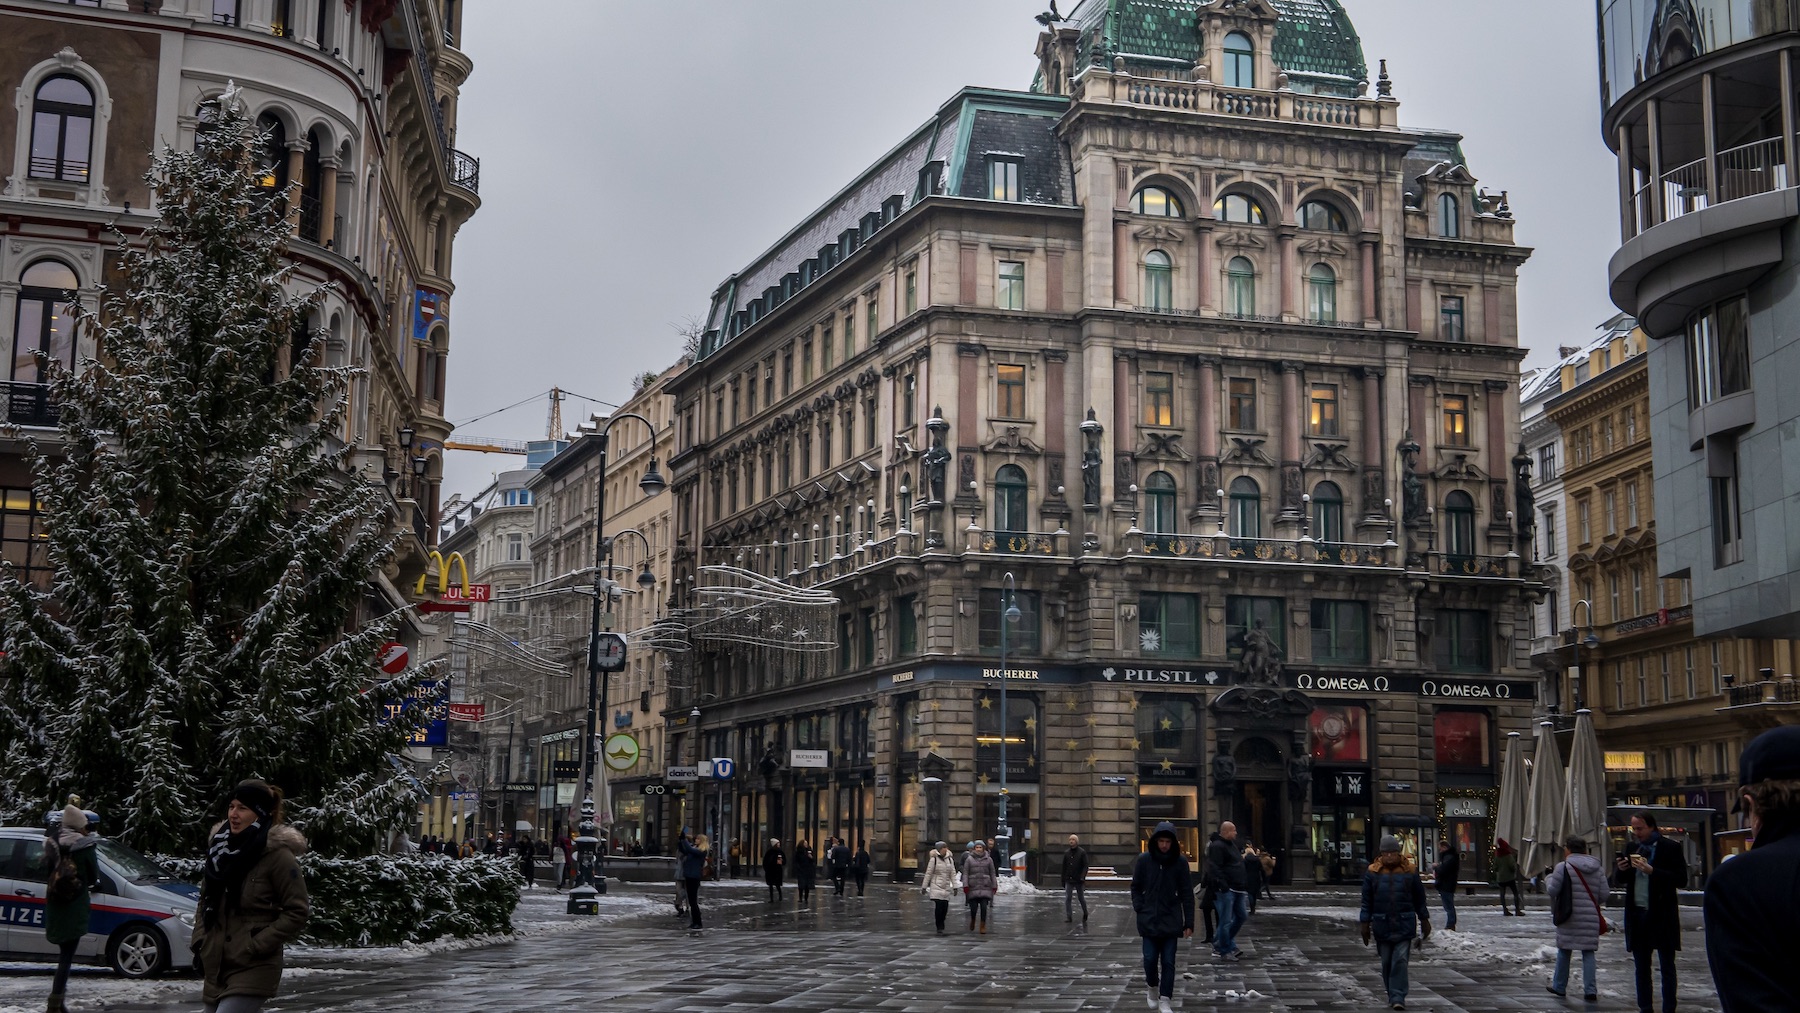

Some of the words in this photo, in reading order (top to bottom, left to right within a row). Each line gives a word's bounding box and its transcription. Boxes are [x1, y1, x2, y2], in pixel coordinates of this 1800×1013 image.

[982, 668, 1039, 680] BUCHERER
[1124, 668, 1197, 683] PILSTL
[1316, 677, 1369, 691] OMEGA
[1440, 684, 1491, 698] OMEGA
[717, 763, 731, 777] U
[1453, 808, 1481, 816] OMEGA
